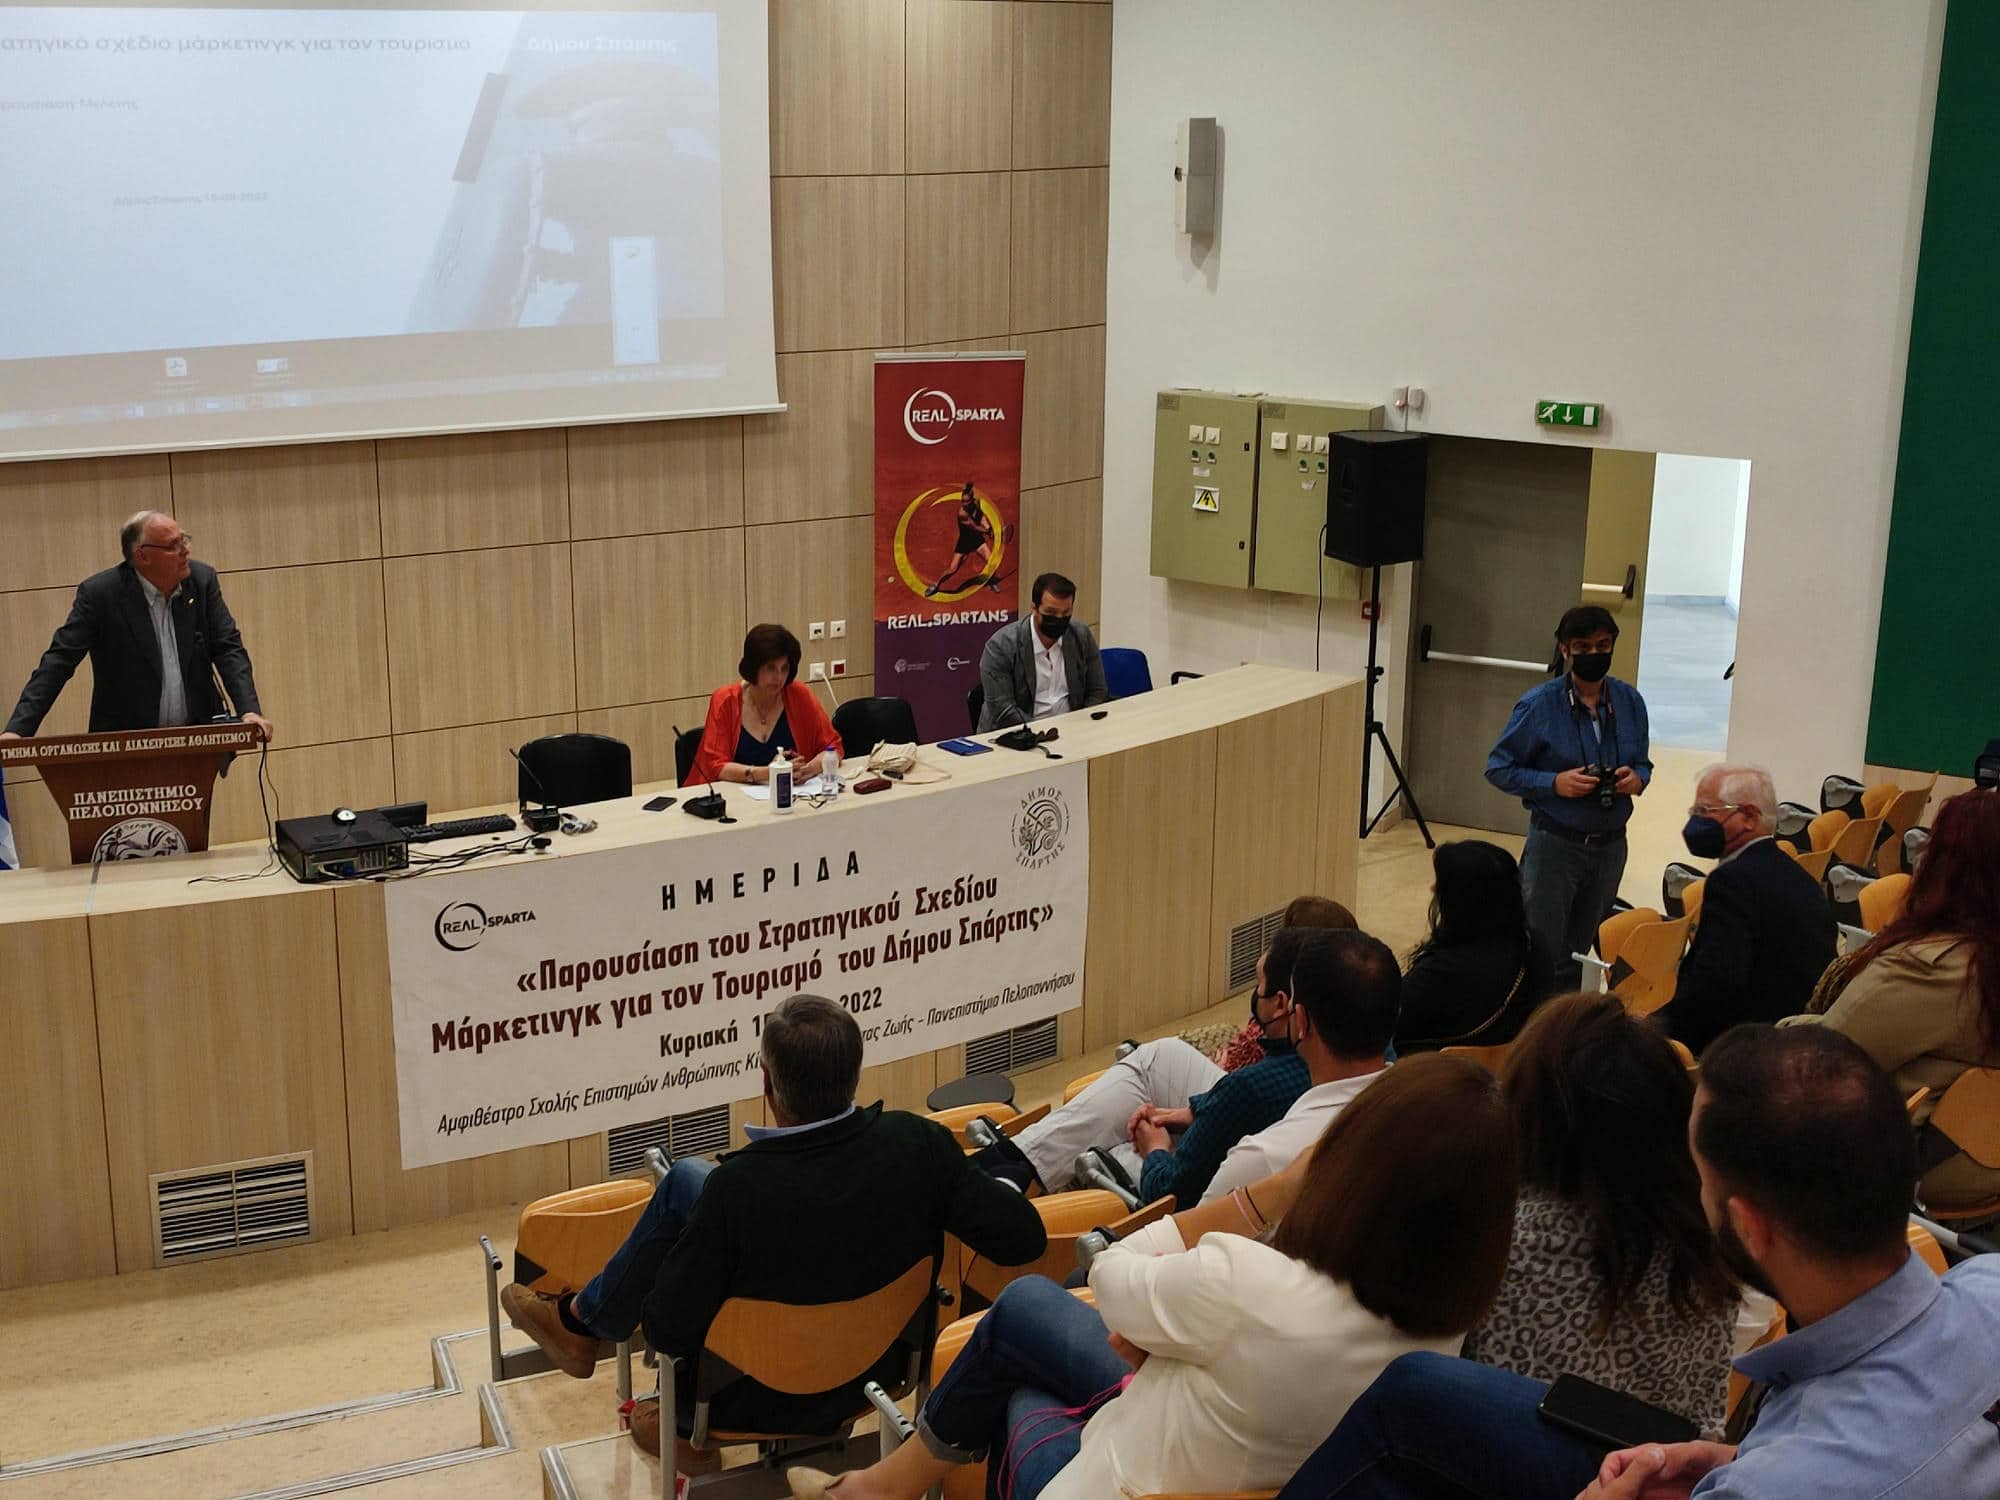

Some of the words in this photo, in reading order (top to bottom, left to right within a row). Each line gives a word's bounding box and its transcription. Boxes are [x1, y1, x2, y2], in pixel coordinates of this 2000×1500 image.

[302, 39, 333, 54] για
[337, 39, 374, 51] τον
[912, 408, 950, 422] REAL
[956, 407, 1005, 421] SPARTA
[1, 746, 38, 760] ΤΜΗΜΑ
[40, 743, 100, 758] ΟΡΓΑΝΩΣΗΣ
[101, 741, 120, 753] ΚΑΙ
[125, 735, 187, 752] ΔΙΑΧΕΙΡΙΣΗΣ
[187, 731, 252, 748] ΑΘΛΗΤΙΣΜΟΥ
[69, 797, 204, 820] ΠΕΛΟΠΟΝΝΗΣΟΥ
[74, 784, 197, 806] ΠΑΝΕΠΙΣΤΗΜΙΟ
[1021, 786, 1061, 809] ΔΗΜΟΣ
[1016, 841, 1065, 869] ΣΠΑΡΤΗΣ
[661, 850, 860, 911] ΗΜΕΡΙΔΑ
[443, 919, 481, 934] REAL
[487, 909, 536, 928] SPARTA
[516, 939, 699, 992] «Παρουσίαση
[708, 931, 750, 958] του
[759, 891, 900, 952] Στρατηγικού
[914, 874, 998, 916] Σχεδίου
[431, 1003, 602, 1054] Μάρκετινγκ
[610, 993, 652, 1029] για
[661, 983, 704, 1011] τον
[711, 949, 823, 1001] Τουρισμό
[838, 946, 876, 972] του
[883, 929, 952, 963] Δήμου
[958, 903, 1054, 945] Σπάρτης»
[660, 1019, 738, 1058] Κυριακή
[437, 1105, 525, 1136] Αμφιθέατρο
[527, 1091, 580, 1117] Σχολής
[582, 1075, 659, 1108] Επιστημών
[660, 1059, 742, 1089] Ανθρώπινης
[882, 1014, 914, 1038] Ζωής
[926, 995, 999, 1026] Πανεπιστήμιο
[1000, 972, 1076, 1006] Πελοποννήσου
